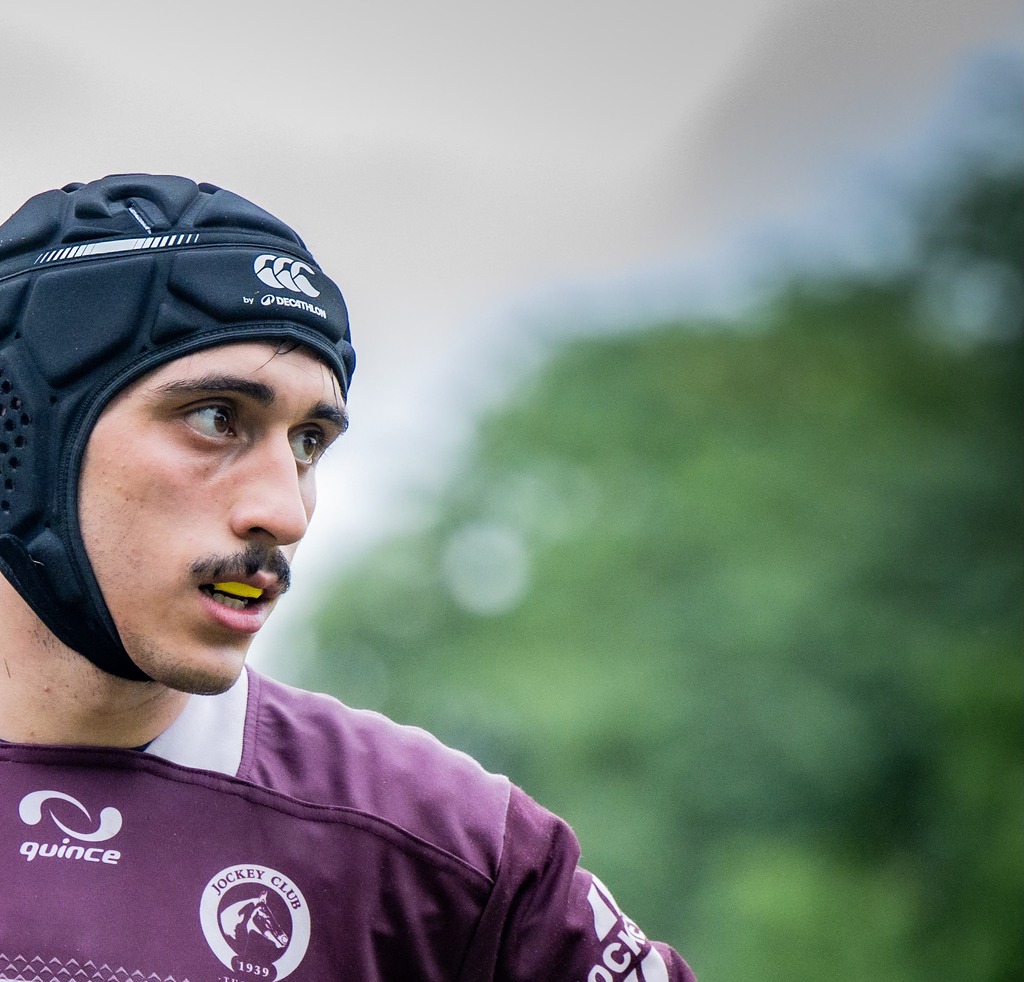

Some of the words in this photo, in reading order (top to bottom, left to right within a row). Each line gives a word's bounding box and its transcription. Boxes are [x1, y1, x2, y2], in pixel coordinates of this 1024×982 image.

[242, 296, 255, 305] by
[275, 296, 327, 319] DECATHLON
[19, 838, 122, 865] quince
[211, 868, 266, 896] JOCKEY
[270, 876, 302, 910] CLUB
[237, 961, 270, 977] 1939
